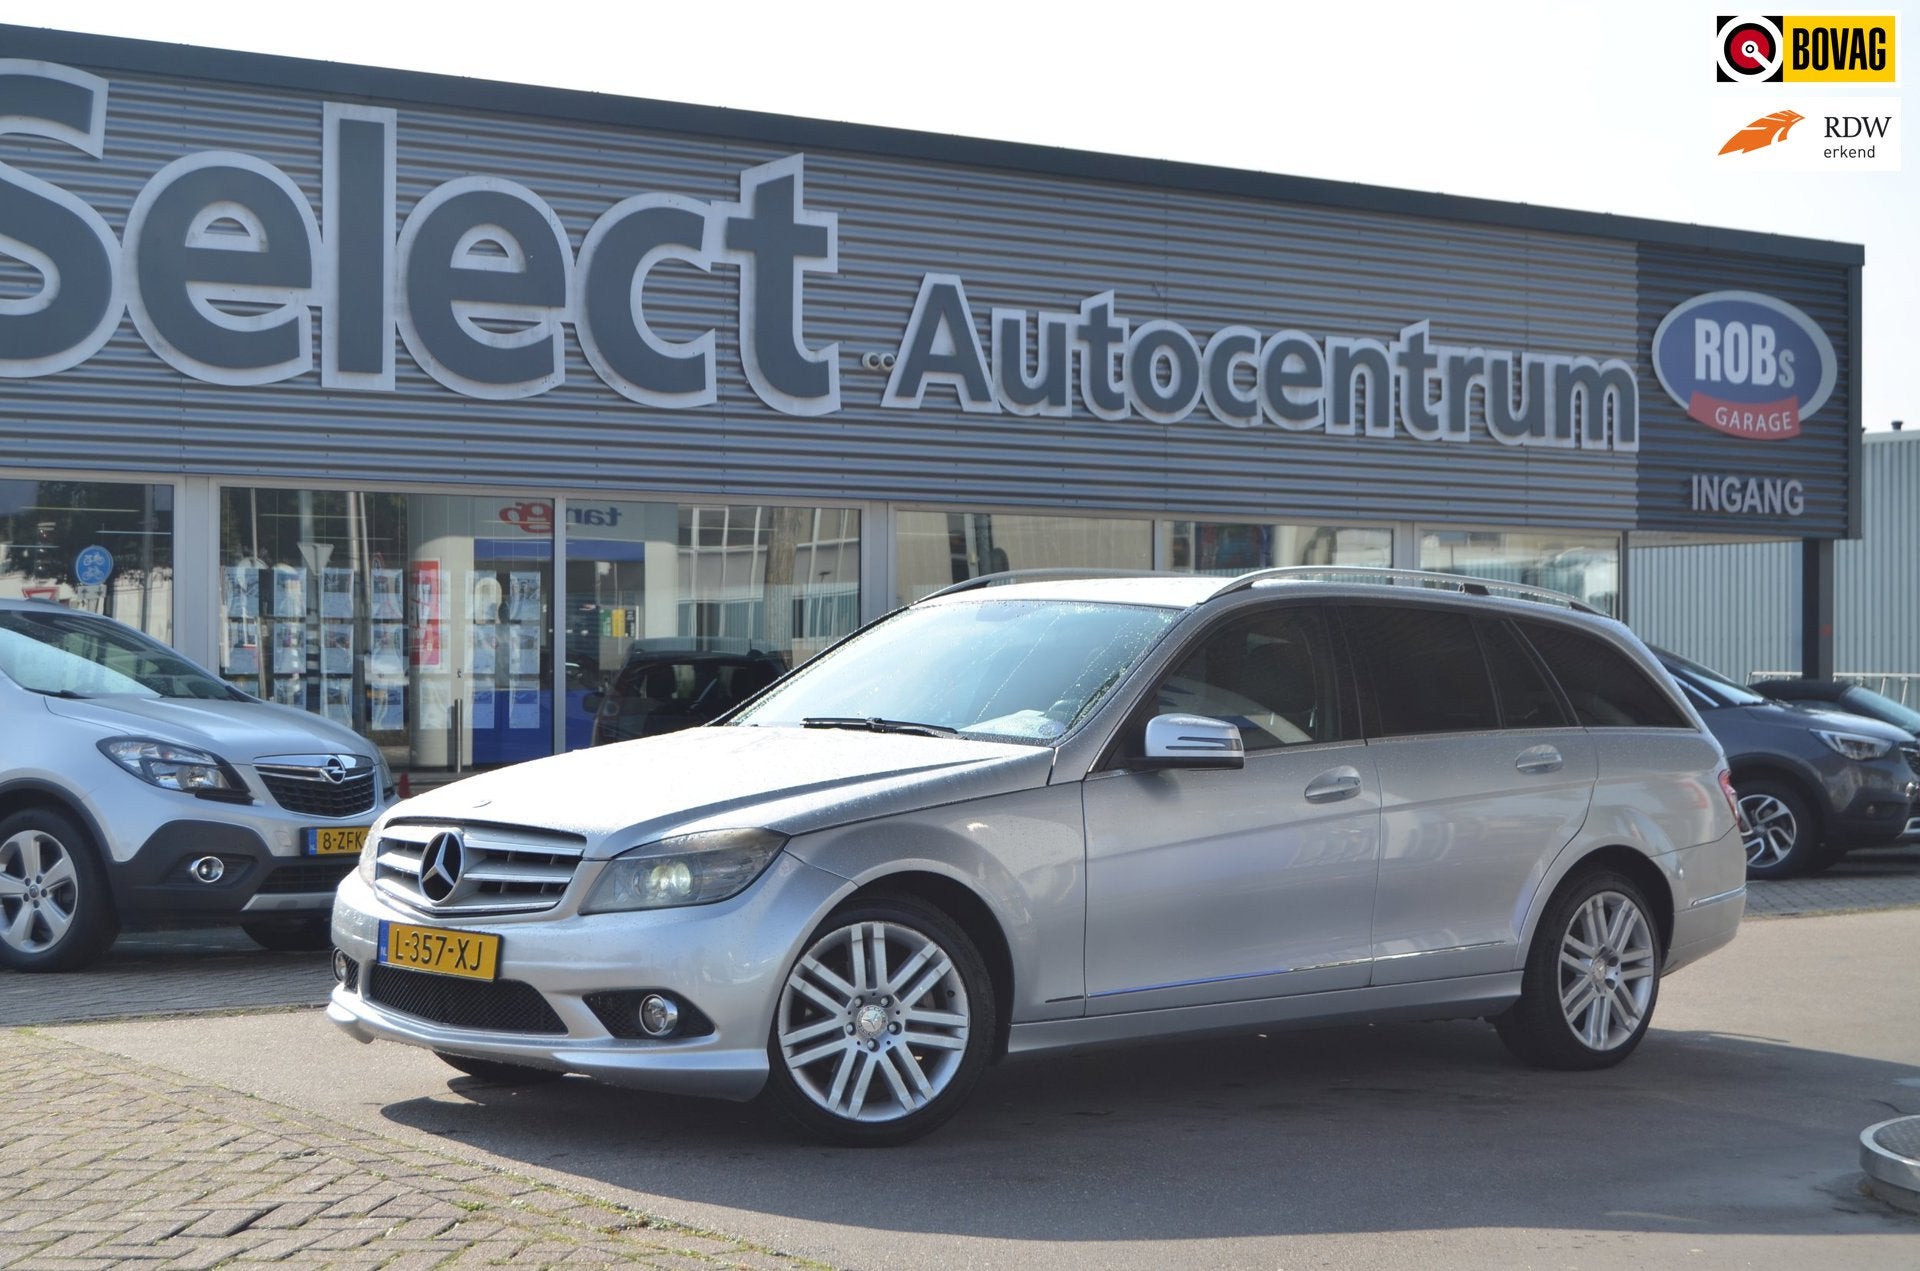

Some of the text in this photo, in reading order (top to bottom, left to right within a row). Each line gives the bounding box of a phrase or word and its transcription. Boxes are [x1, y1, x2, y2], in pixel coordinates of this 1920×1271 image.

[0, 58, 1639, 452] Select Autocentrum
[1715, 406, 1792, 432] GARAGE
[1691, 474, 1804, 516] INGANG
[395, 929, 483, 971] L-357-XJ
